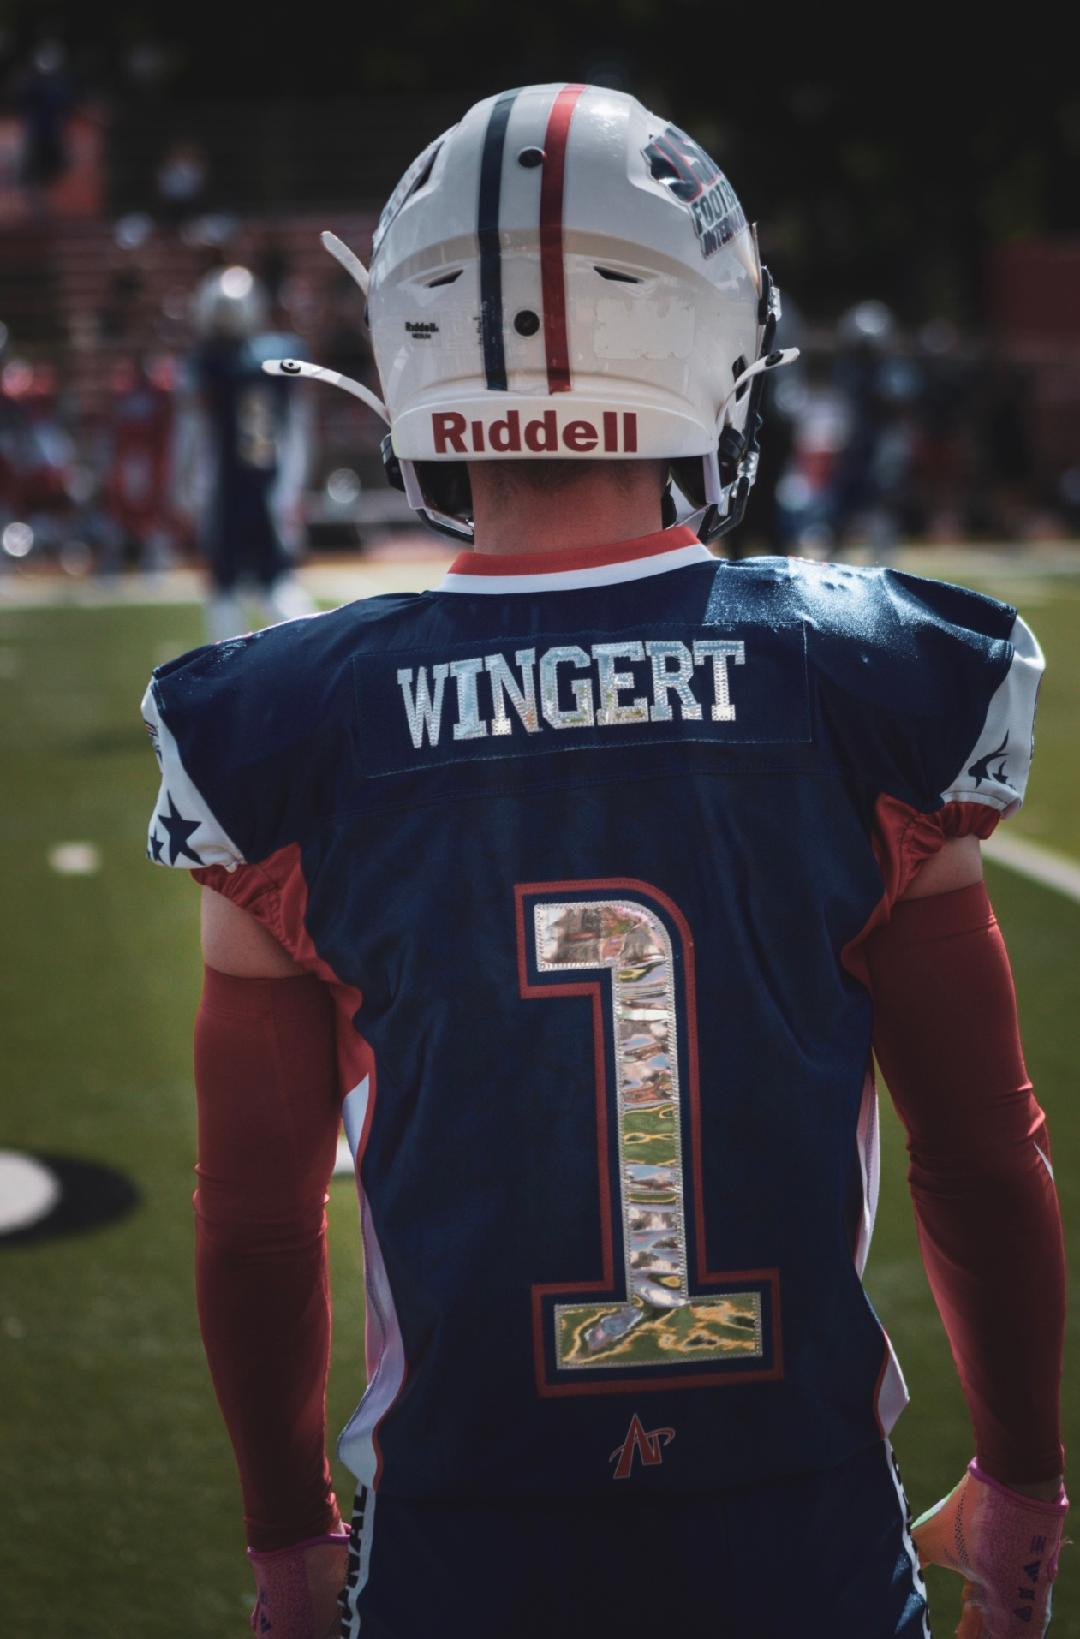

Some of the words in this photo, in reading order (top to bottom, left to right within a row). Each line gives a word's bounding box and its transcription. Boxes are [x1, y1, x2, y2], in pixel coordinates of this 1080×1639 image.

[431, 410, 638, 454] Riddell
[397, 640, 746, 749] WINGERT
[514, 878, 784, 1398] 1
